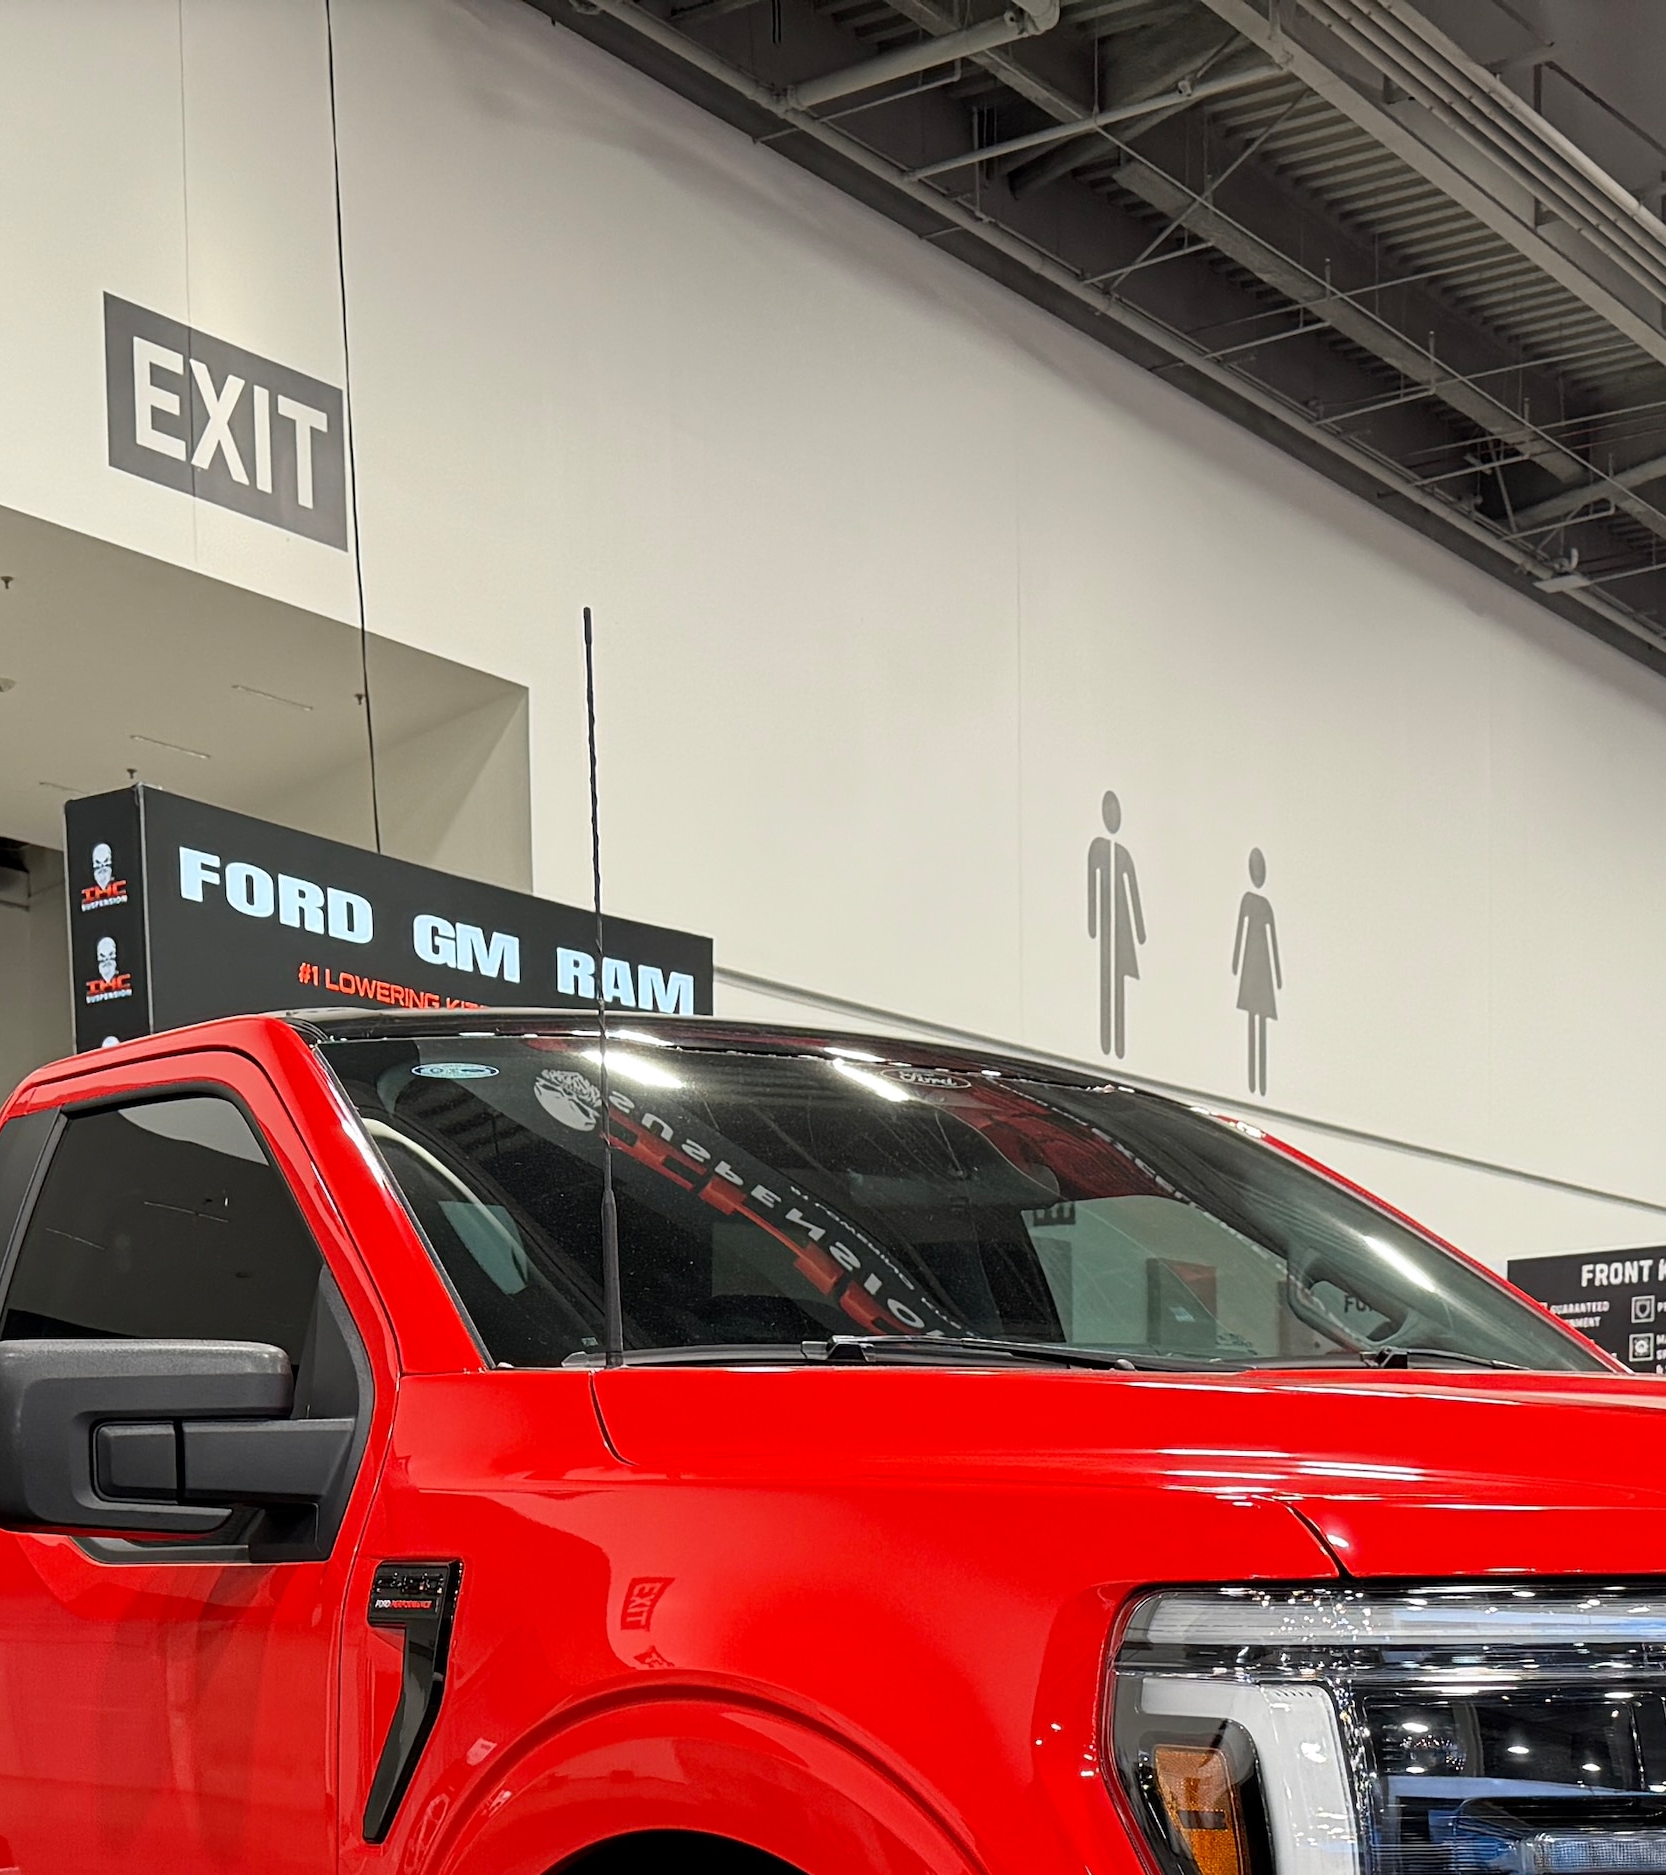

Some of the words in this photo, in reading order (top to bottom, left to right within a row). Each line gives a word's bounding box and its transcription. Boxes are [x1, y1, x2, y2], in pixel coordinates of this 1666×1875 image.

[133, 335, 327, 509] EXIT
[178, 845, 374, 944] FORD
[413, 914, 521, 984] GM
[556, 945, 694, 1015] RAM
[298, 962, 320, 988] #1
[325, 968, 439, 1008] LOWERING
[1581, 1259, 1653, 1287] FRONT
